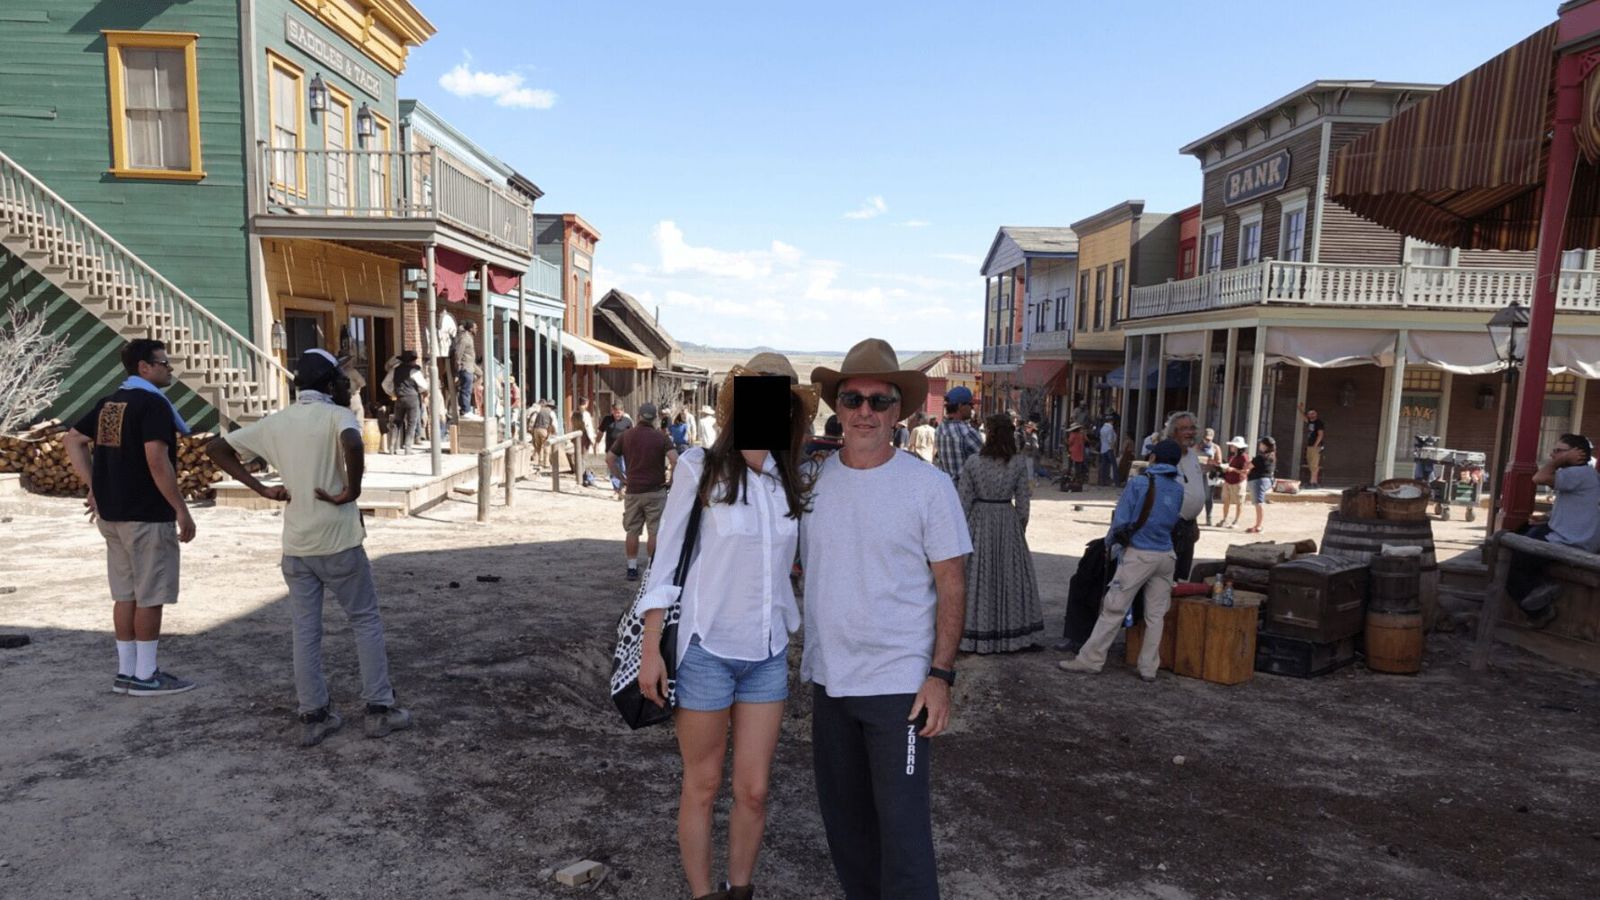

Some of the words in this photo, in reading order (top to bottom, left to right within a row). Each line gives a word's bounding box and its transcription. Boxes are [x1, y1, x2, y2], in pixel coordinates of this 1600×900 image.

[289, 19, 343, 71] SADDLES
[345, 59, 353, 76] &
[354, 65, 379, 96] TACK
[1229, 157, 1282, 199] BANK
[1402, 405, 1433, 420] ANK
[906, 724, 916, 775] ZORRO
